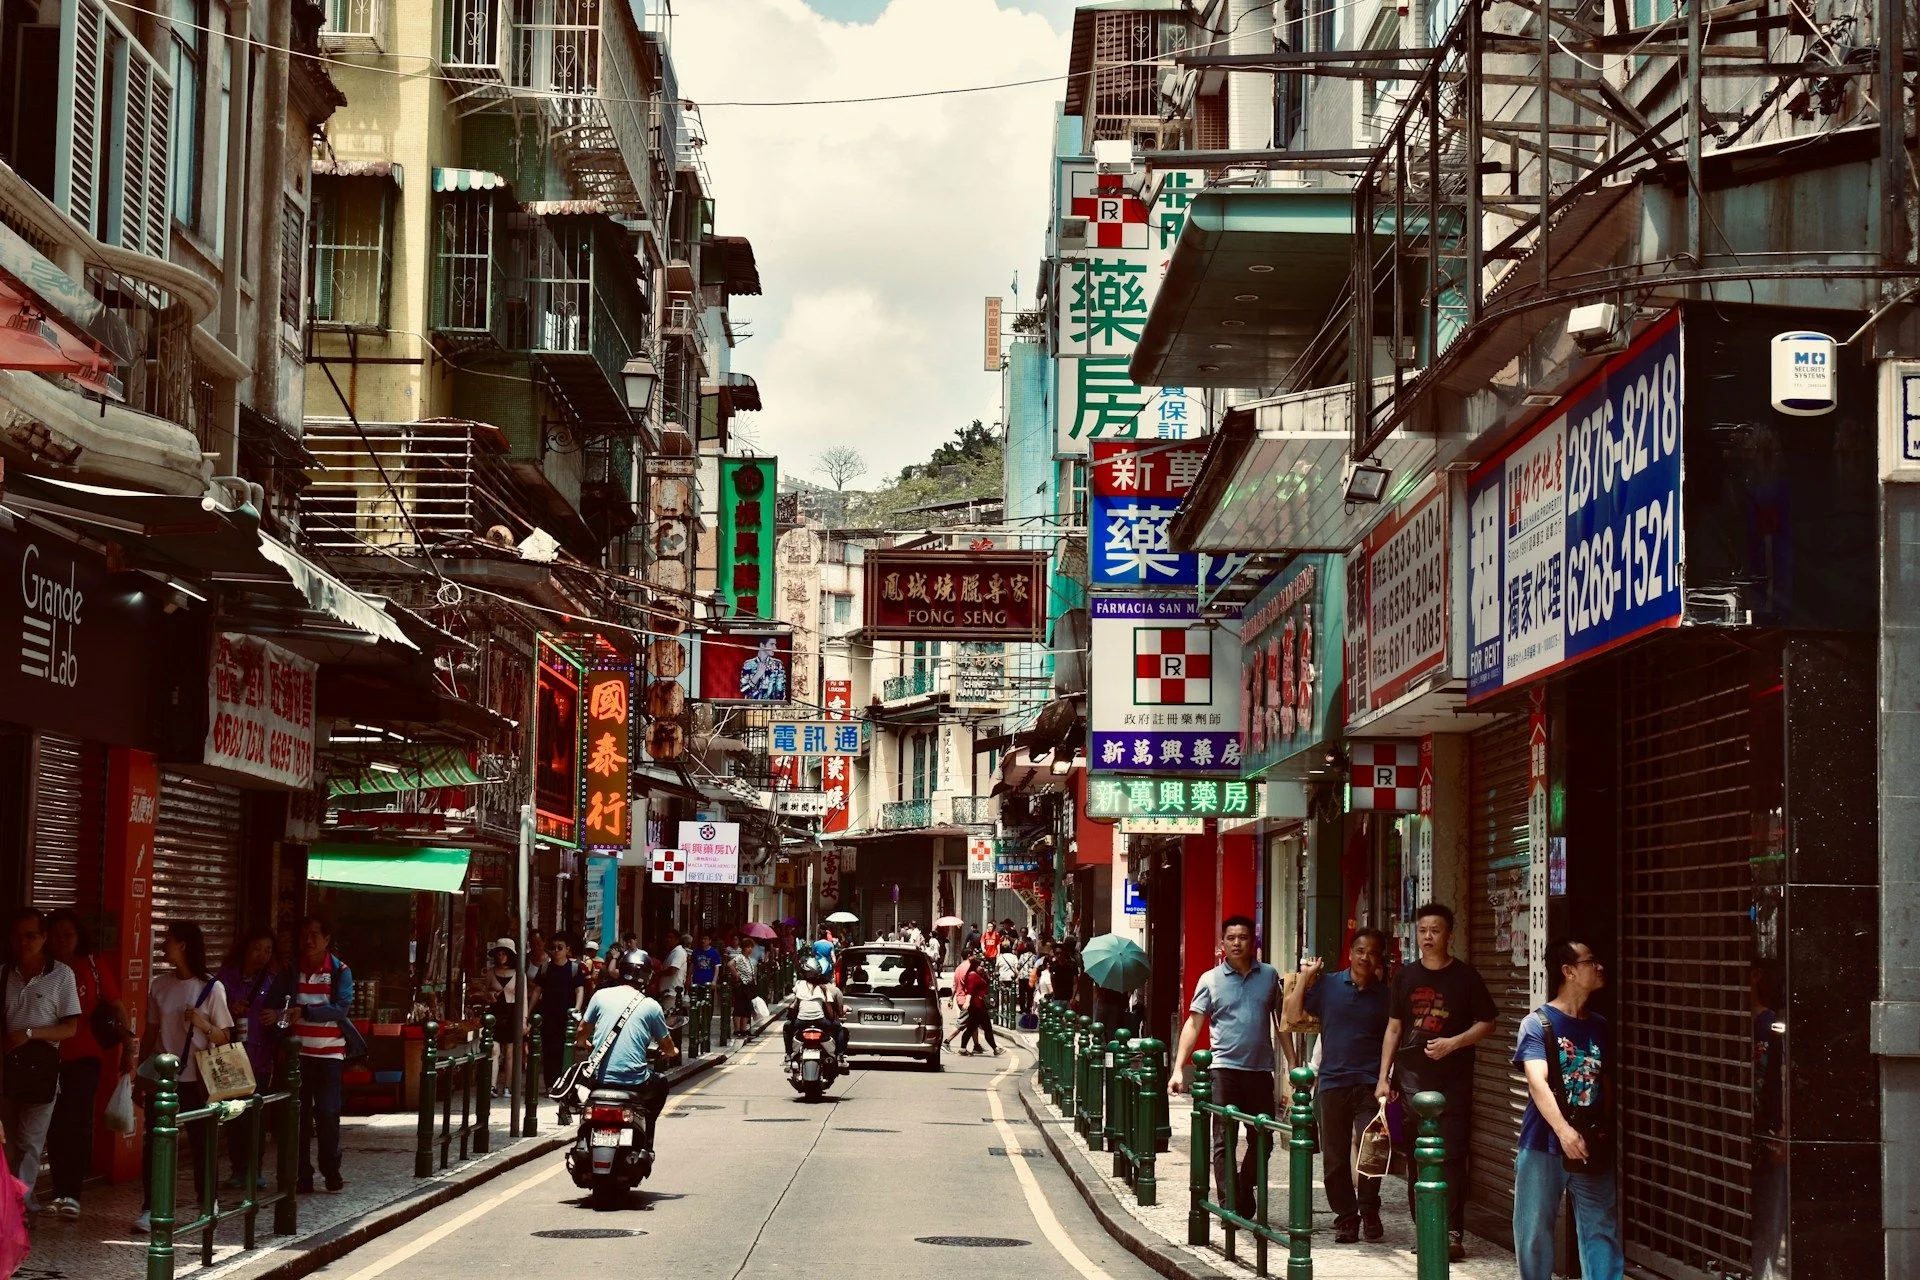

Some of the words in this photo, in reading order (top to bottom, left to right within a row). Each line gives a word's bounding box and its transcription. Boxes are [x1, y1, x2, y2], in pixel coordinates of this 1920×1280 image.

[1068, 257, 1148, 440] 藥房
[1567, 353, 1677, 516] 2876-8218
[22, 543, 83, 625] Grande
[1470, 482, 1500, 646] 租
[1567, 490, 1674, 636] 6268-1521
[907, 610, 955, 624] FONG
[963, 610, 1007, 624] SENG
[1158, 602, 1181, 613] SAN
[1507, 551, 1562, 643] 獨家代理
[51, 618, 78, 688] Lab
[1470, 649, 1483, 676] FOR
[1484, 640, 1500, 671] RENT
[773, 724, 858, 753] 電訊通
[1124, 713, 1222, 726] 政府註冊藥劑師
[586, 679, 628, 837] 國泰行
[1101, 737, 1242, 766] 新萬興藥房
[1095, 780, 1249, 813] 新萬興藥房
[998, 874, 1011, 883] 24
